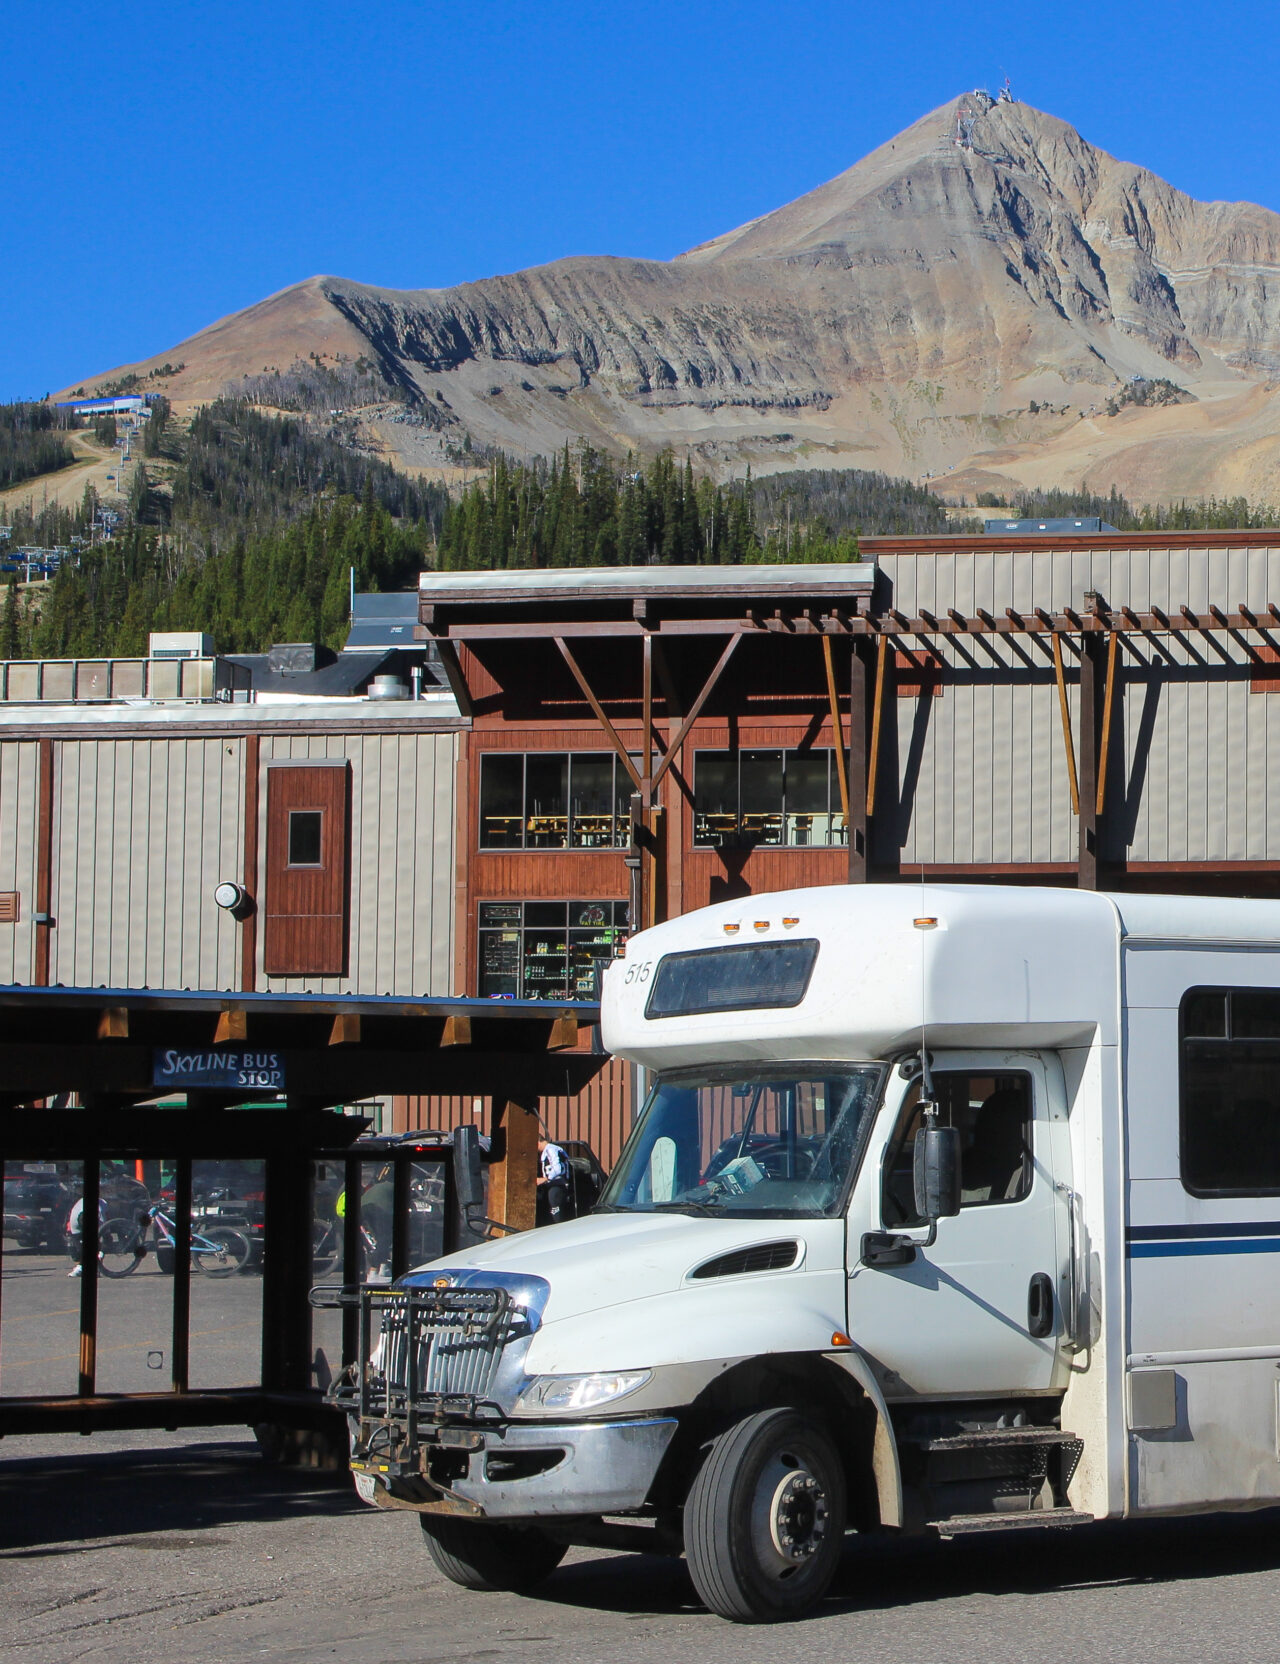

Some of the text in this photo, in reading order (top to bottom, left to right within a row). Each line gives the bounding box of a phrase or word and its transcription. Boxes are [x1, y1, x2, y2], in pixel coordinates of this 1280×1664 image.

[624, 961, 652, 984] 515
[162, 1050, 278, 1074] SKYLINE BUS
[238, 1070, 280, 1085] STOP
